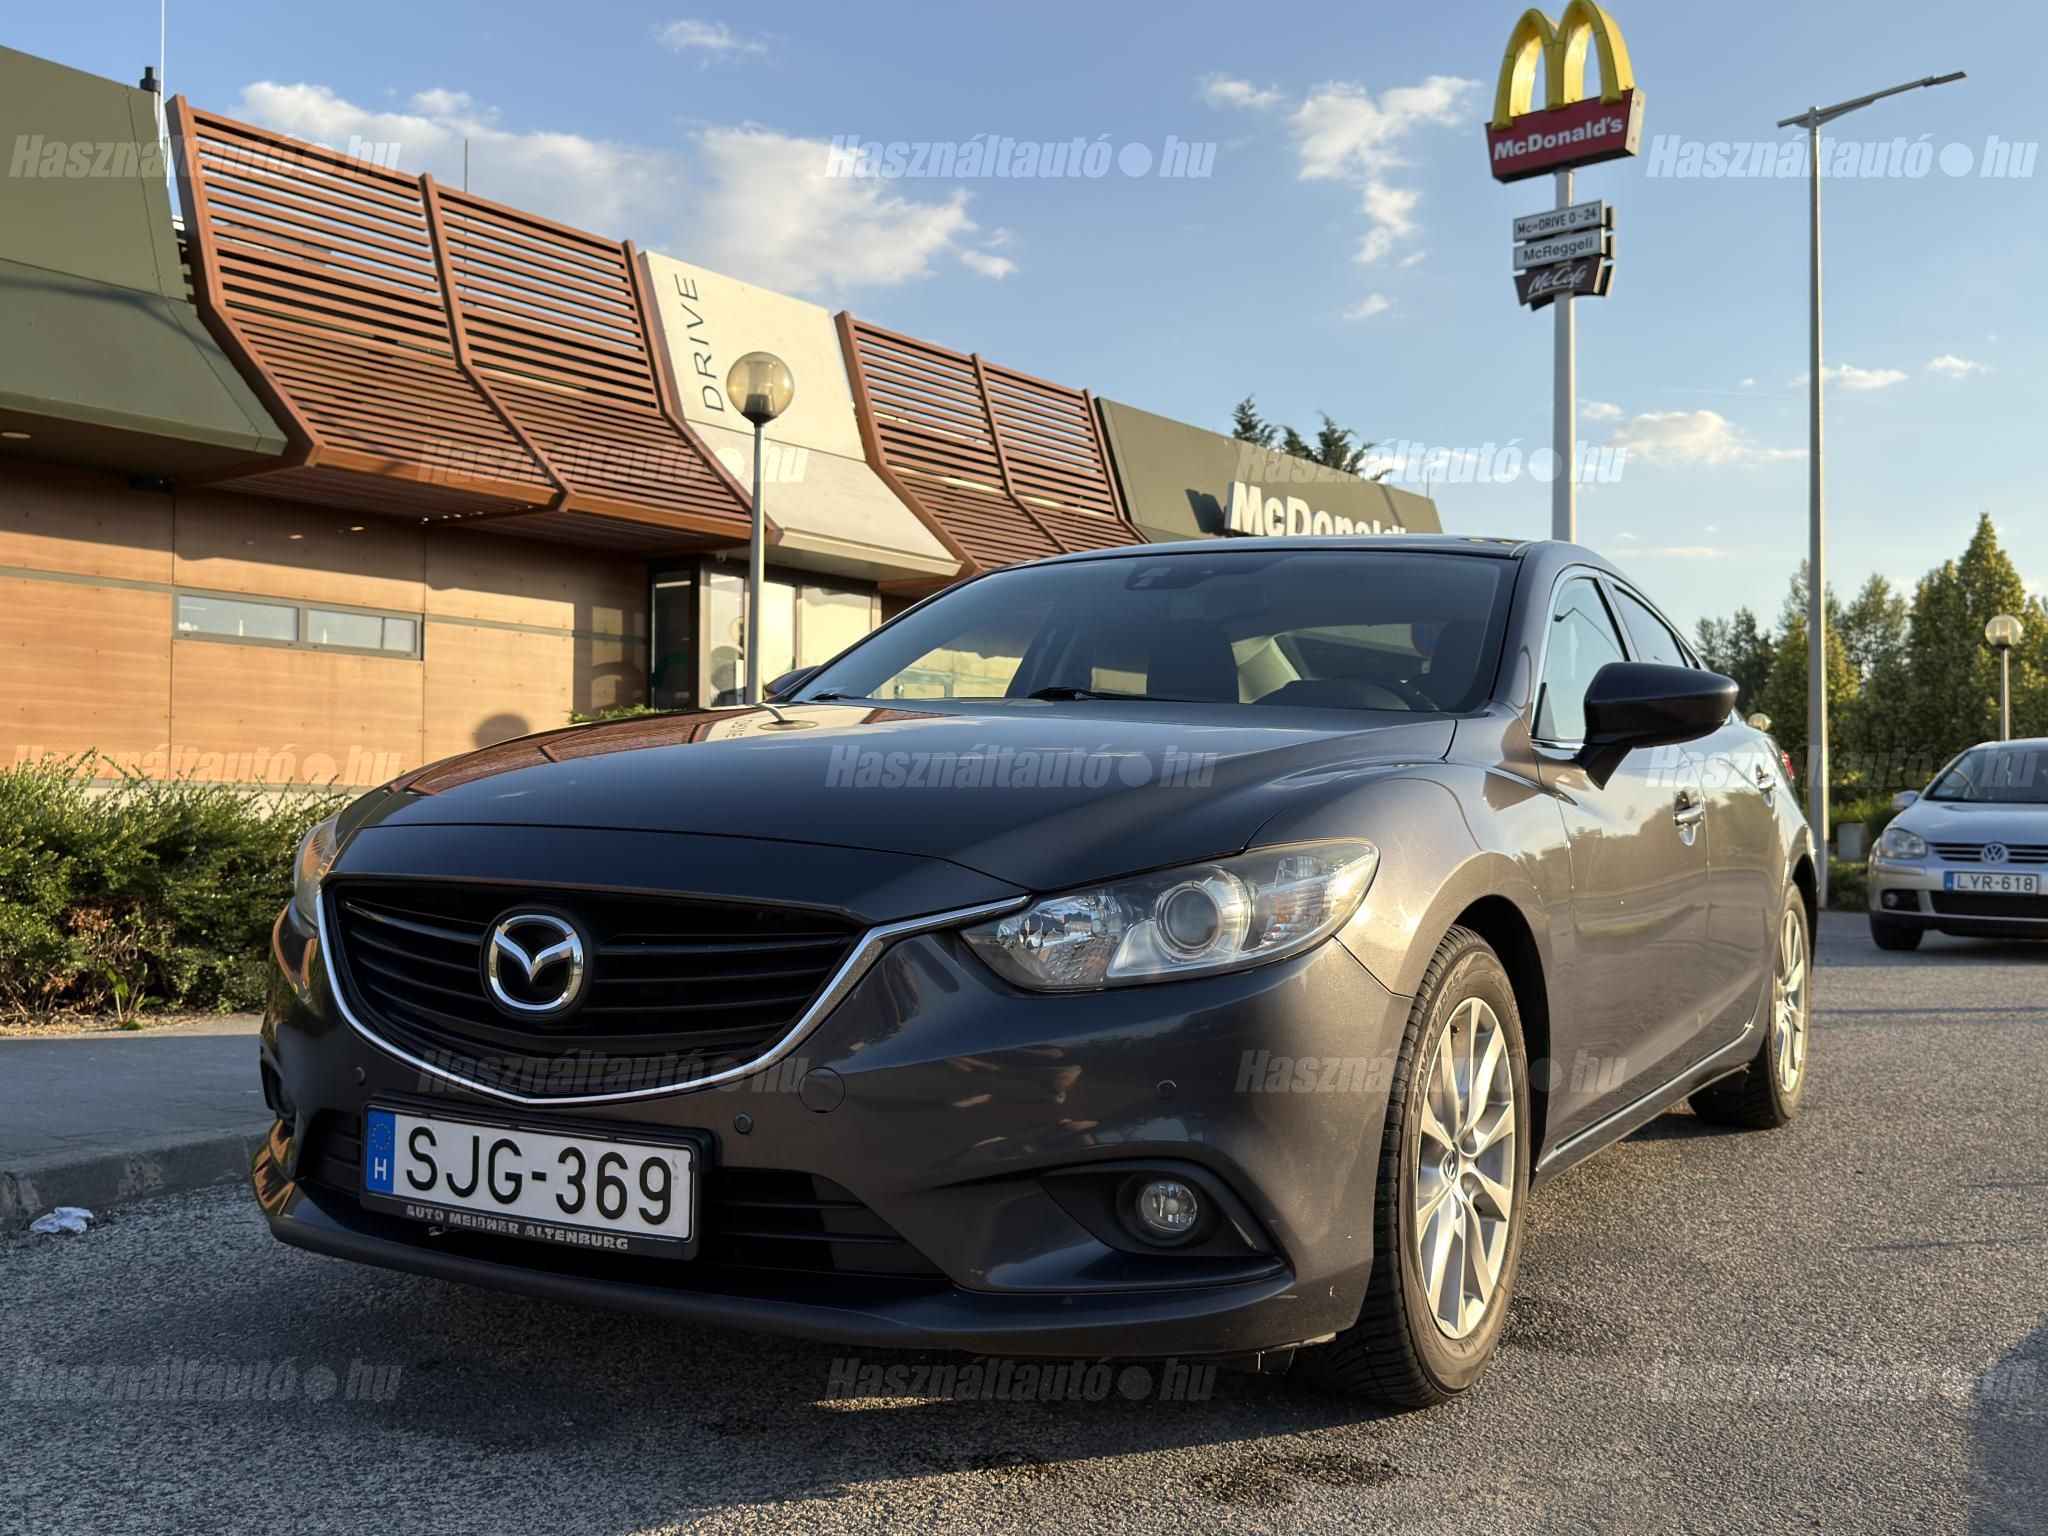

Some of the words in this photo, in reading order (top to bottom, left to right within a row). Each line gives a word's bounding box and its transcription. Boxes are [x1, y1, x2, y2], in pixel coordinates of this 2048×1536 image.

[1494, 117, 1623, 160] McDonald's
[1522, 237, 1593, 262] McReggeli
[674, 273, 726, 412] DRIVE
[1957, 874, 2034, 892] LYR-618
[373, 1157, 388, 1183] H
[406, 1126, 673, 1226] SJG-369
[405, 1204, 445, 1222] AUTO
[524, 1223, 629, 1251] ALTENBURG
